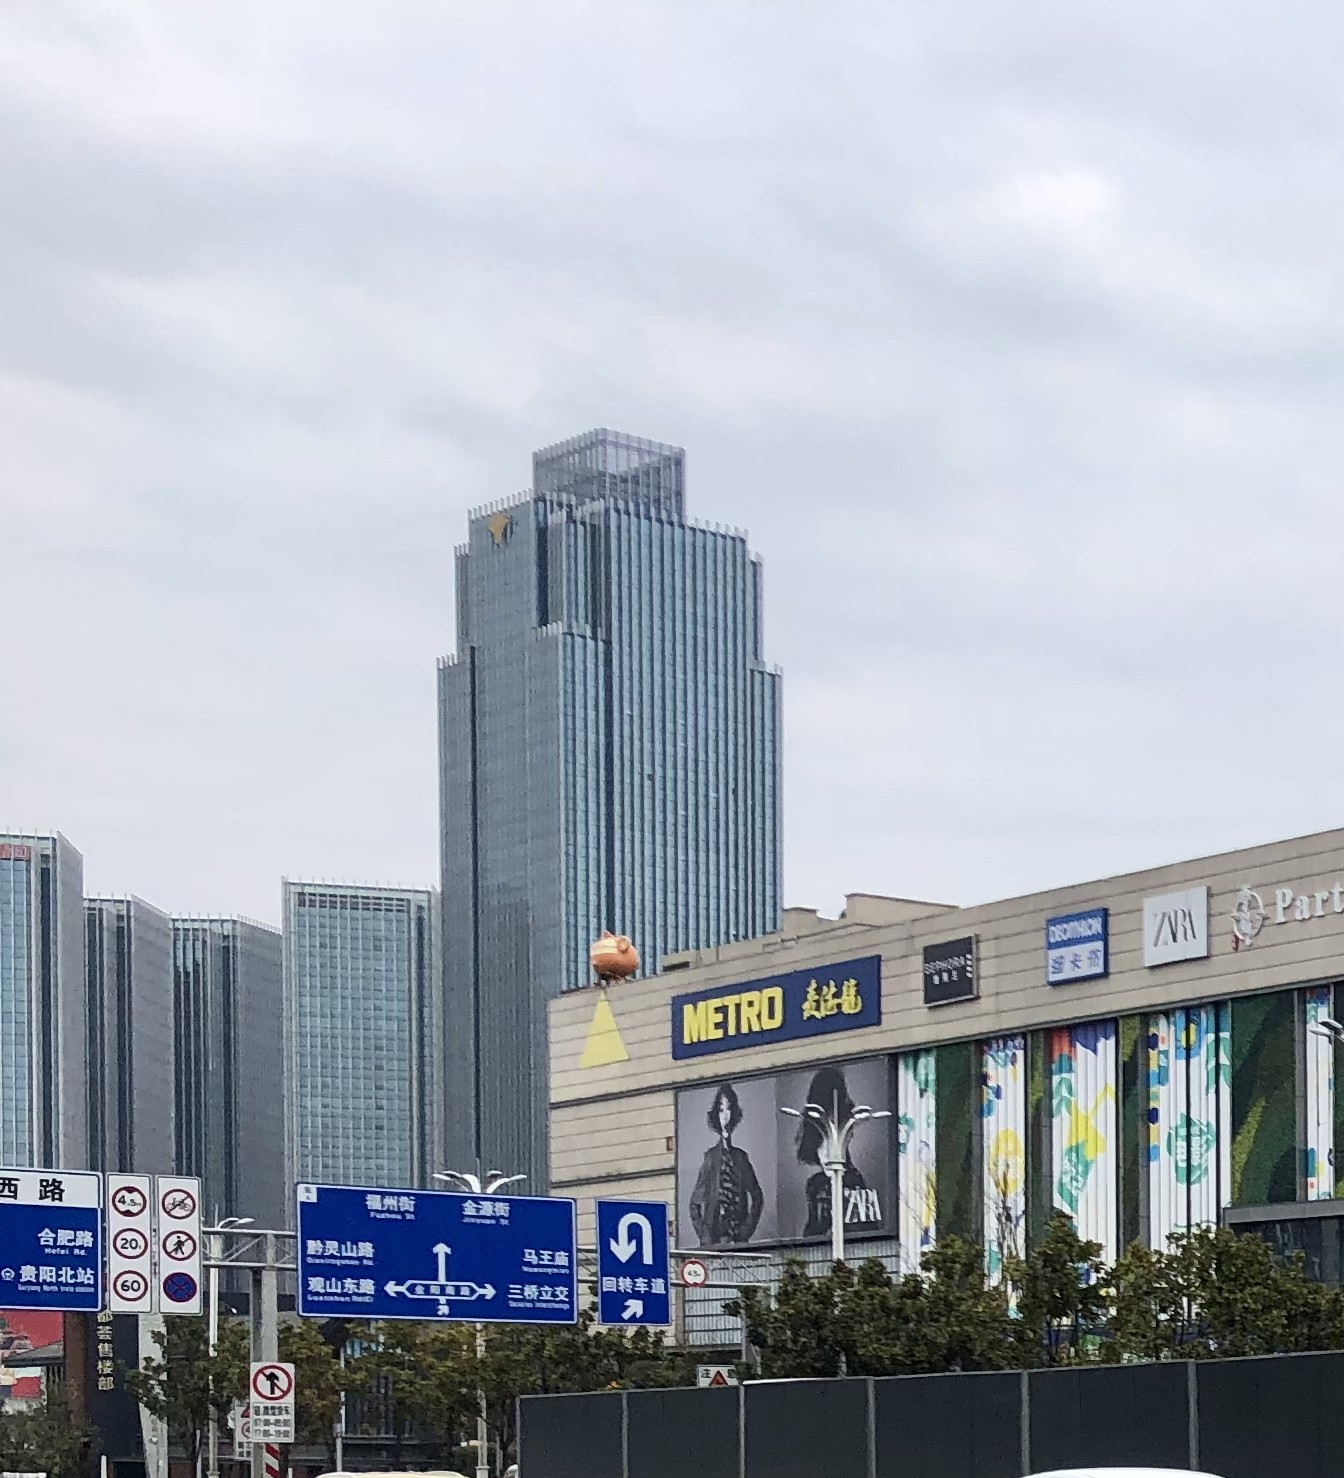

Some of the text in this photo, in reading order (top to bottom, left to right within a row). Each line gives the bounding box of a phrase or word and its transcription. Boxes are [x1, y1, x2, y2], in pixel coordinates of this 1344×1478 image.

[683, 986, 784, 1046] METRO
[38, 1227, 95, 1248] 合肥路
[44, 1248, 70, 1256] Hefei
[306, 1239, 376, 1258] 黔灵山路
[522, 1248, 570, 1266] 马王庙
[19, 1265, 96, 1285] 贵阳北站
[120, 1279, 141, 1292] 60
[307, 1276, 376, 1295] 观山东路
[507, 1284, 570, 1302] 三桥立交
[602, 1276, 667, 1294] 回转车道
